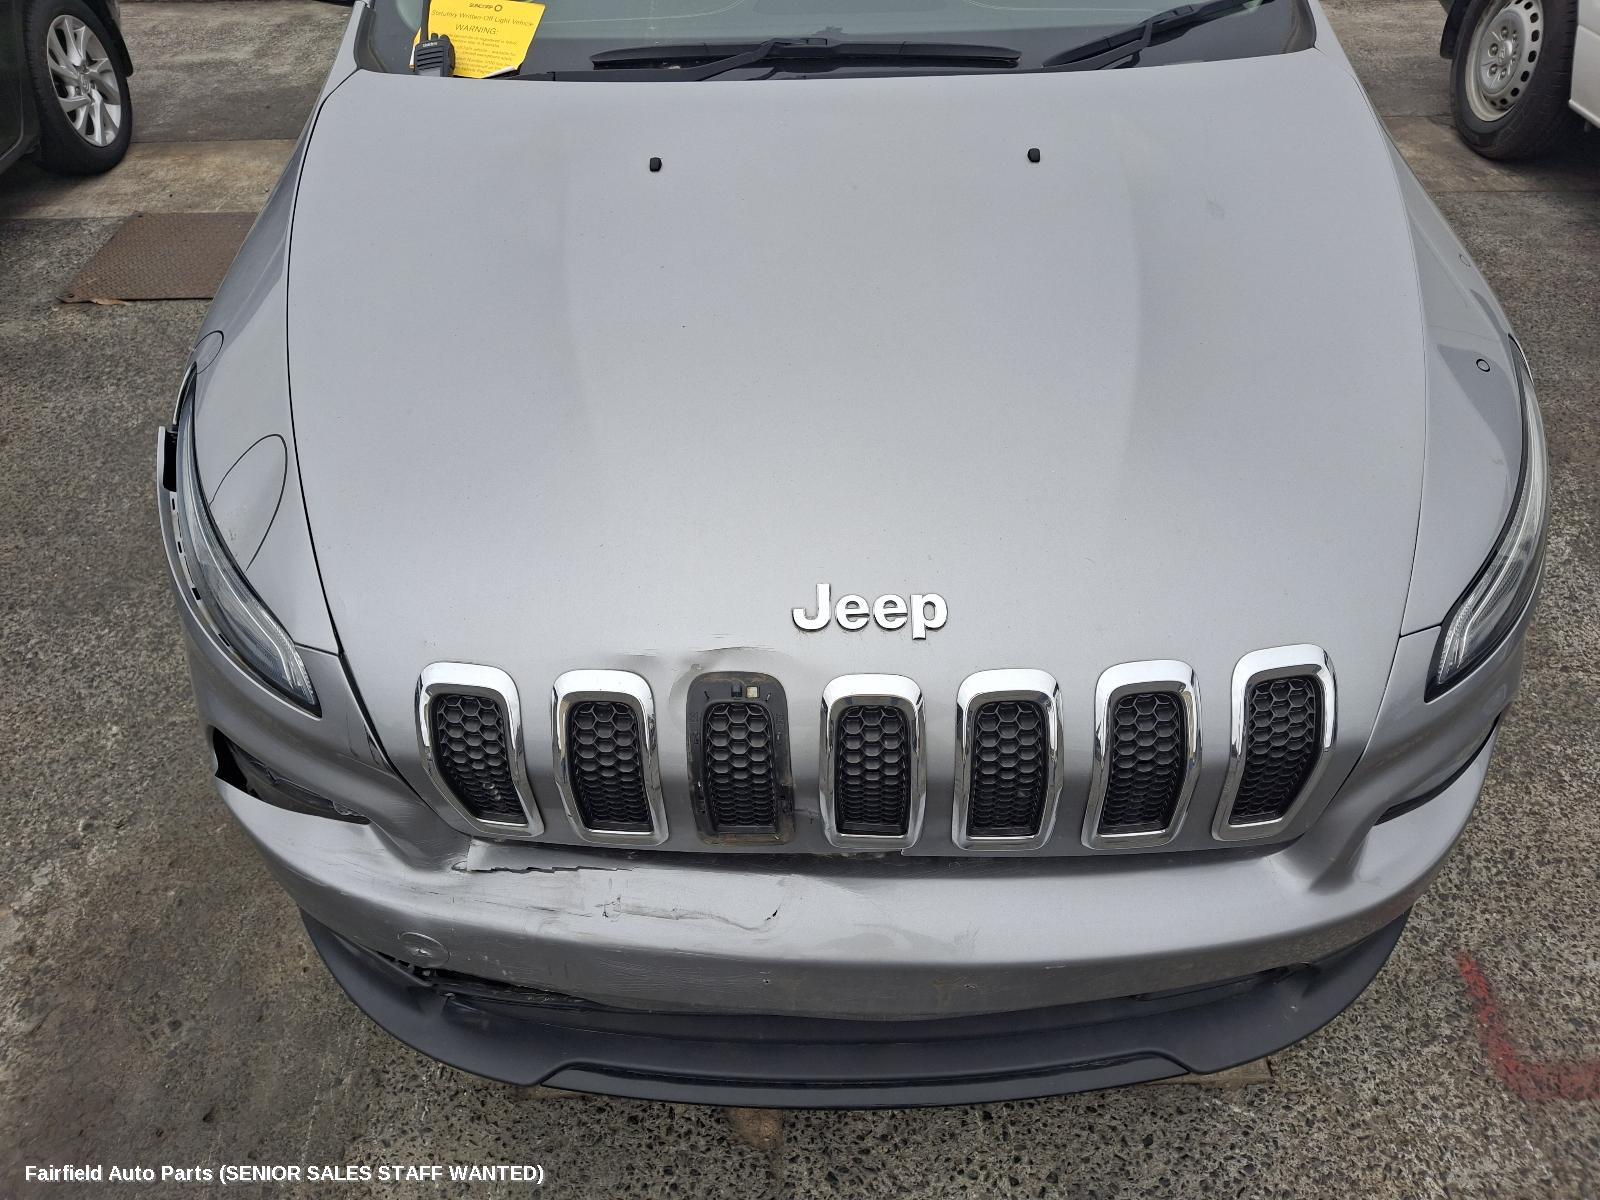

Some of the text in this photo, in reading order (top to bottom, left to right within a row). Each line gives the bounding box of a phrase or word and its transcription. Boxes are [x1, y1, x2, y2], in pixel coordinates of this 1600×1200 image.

[431, 9, 458, 18] Statutory
[494, 16, 510, 24] Light
[512, 18, 534, 26] Vehicle
[792, 583, 948, 640] Jeep
